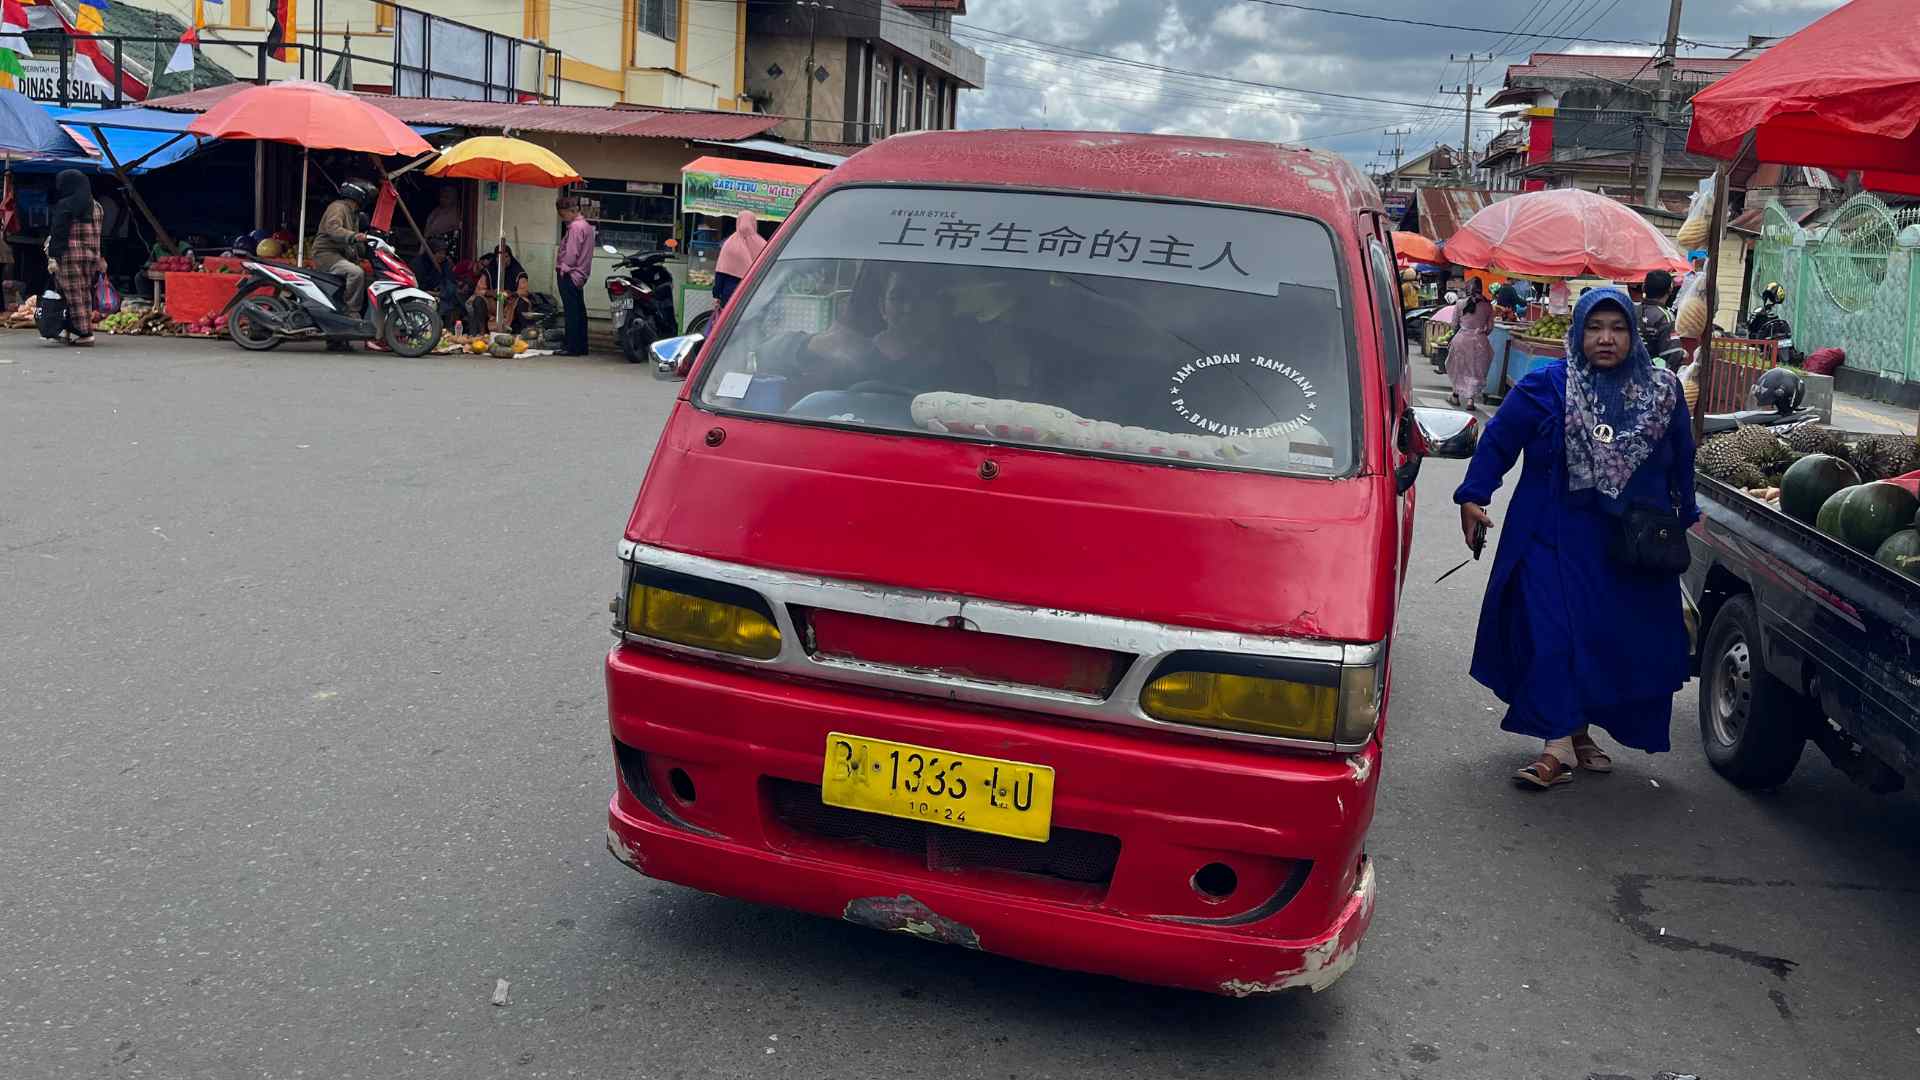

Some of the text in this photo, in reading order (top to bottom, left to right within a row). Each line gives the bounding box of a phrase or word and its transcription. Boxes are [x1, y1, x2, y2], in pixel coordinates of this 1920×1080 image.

[22, 65, 50, 73] MERINTAH
[19, 76, 53, 99] DINAS
[878, 218, 1250, 277] 上帝生命的主人
[1171, 363, 1196, 384] JAM
[1196, 353, 1240, 369] GADAN
